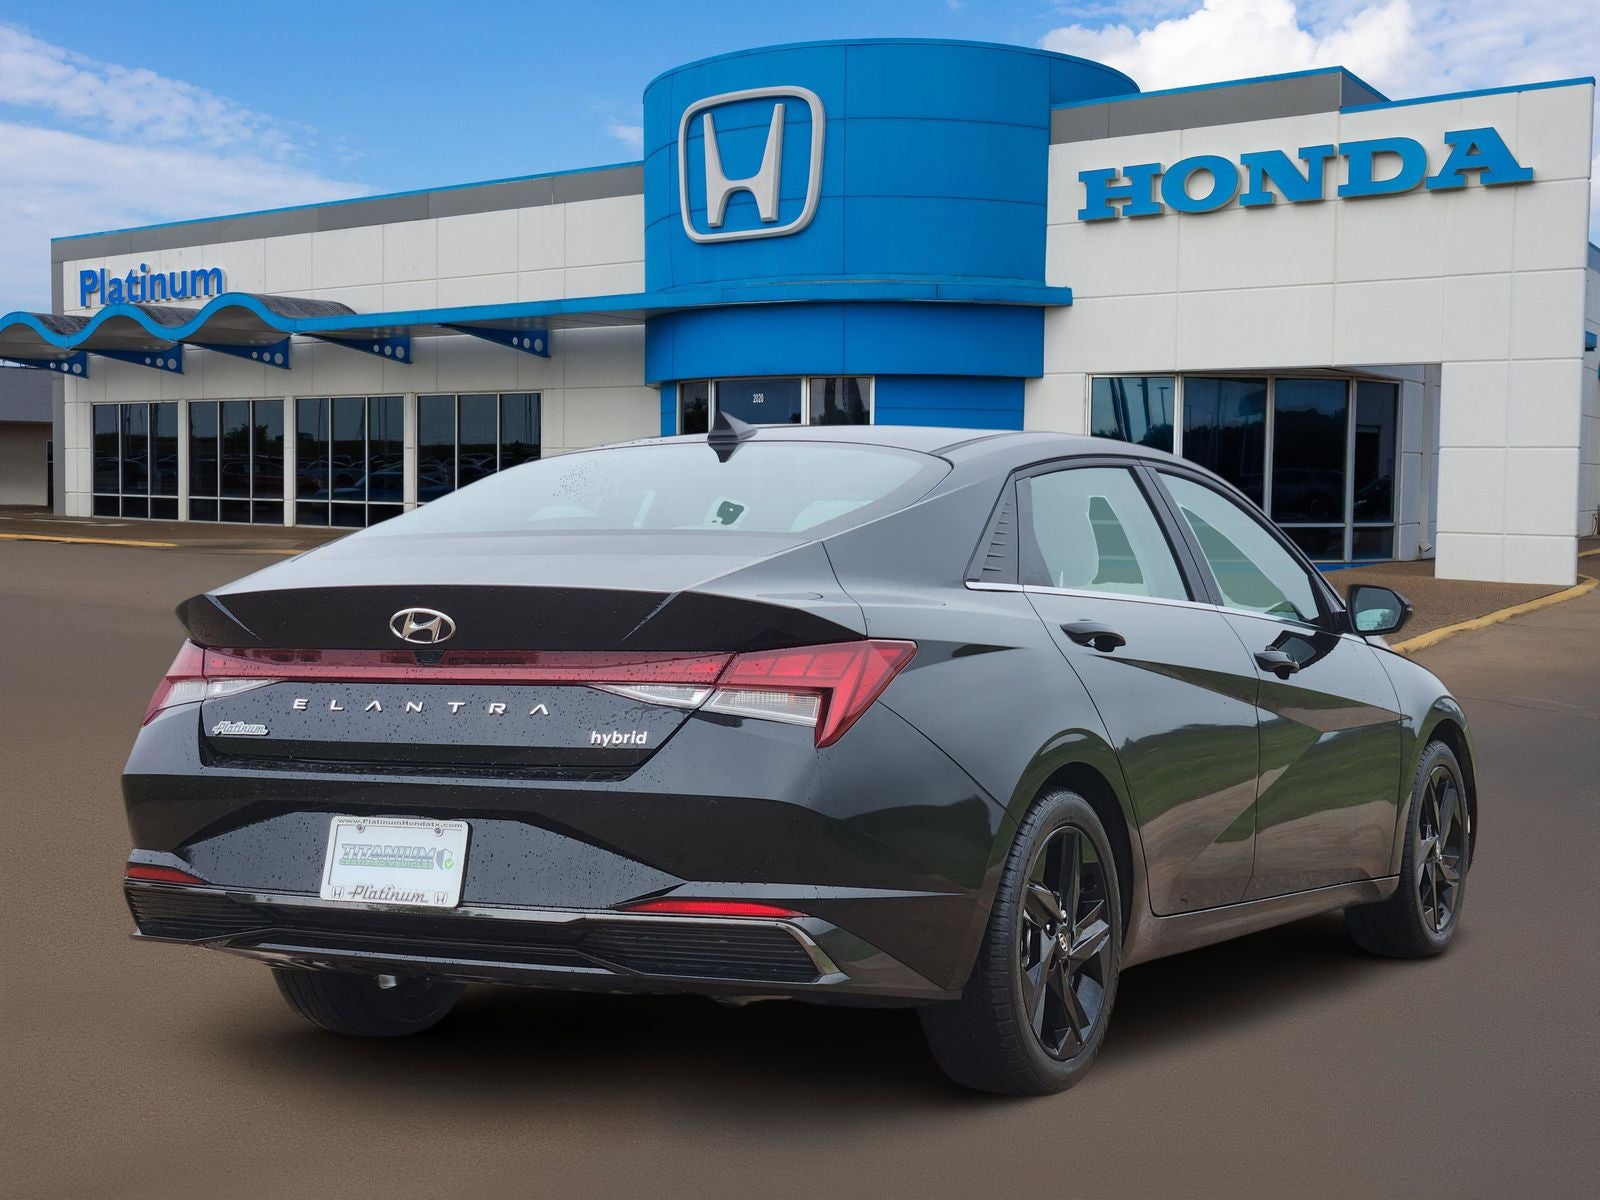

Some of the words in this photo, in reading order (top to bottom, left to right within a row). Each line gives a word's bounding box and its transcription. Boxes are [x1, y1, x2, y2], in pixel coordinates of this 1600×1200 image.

[1078, 126, 1534, 222] HONDA
[79, 263, 227, 308] Platinum
[292, 698, 550, 716] ELANTRA
[212, 720, 269, 736] Platinum
[589, 730, 648, 747] hybrid
[338, 818, 463, 828] www.PlatinumHondatx.com
[341, 844, 436, 861] TITANIUM
[348, 885, 428, 903] Platinum
